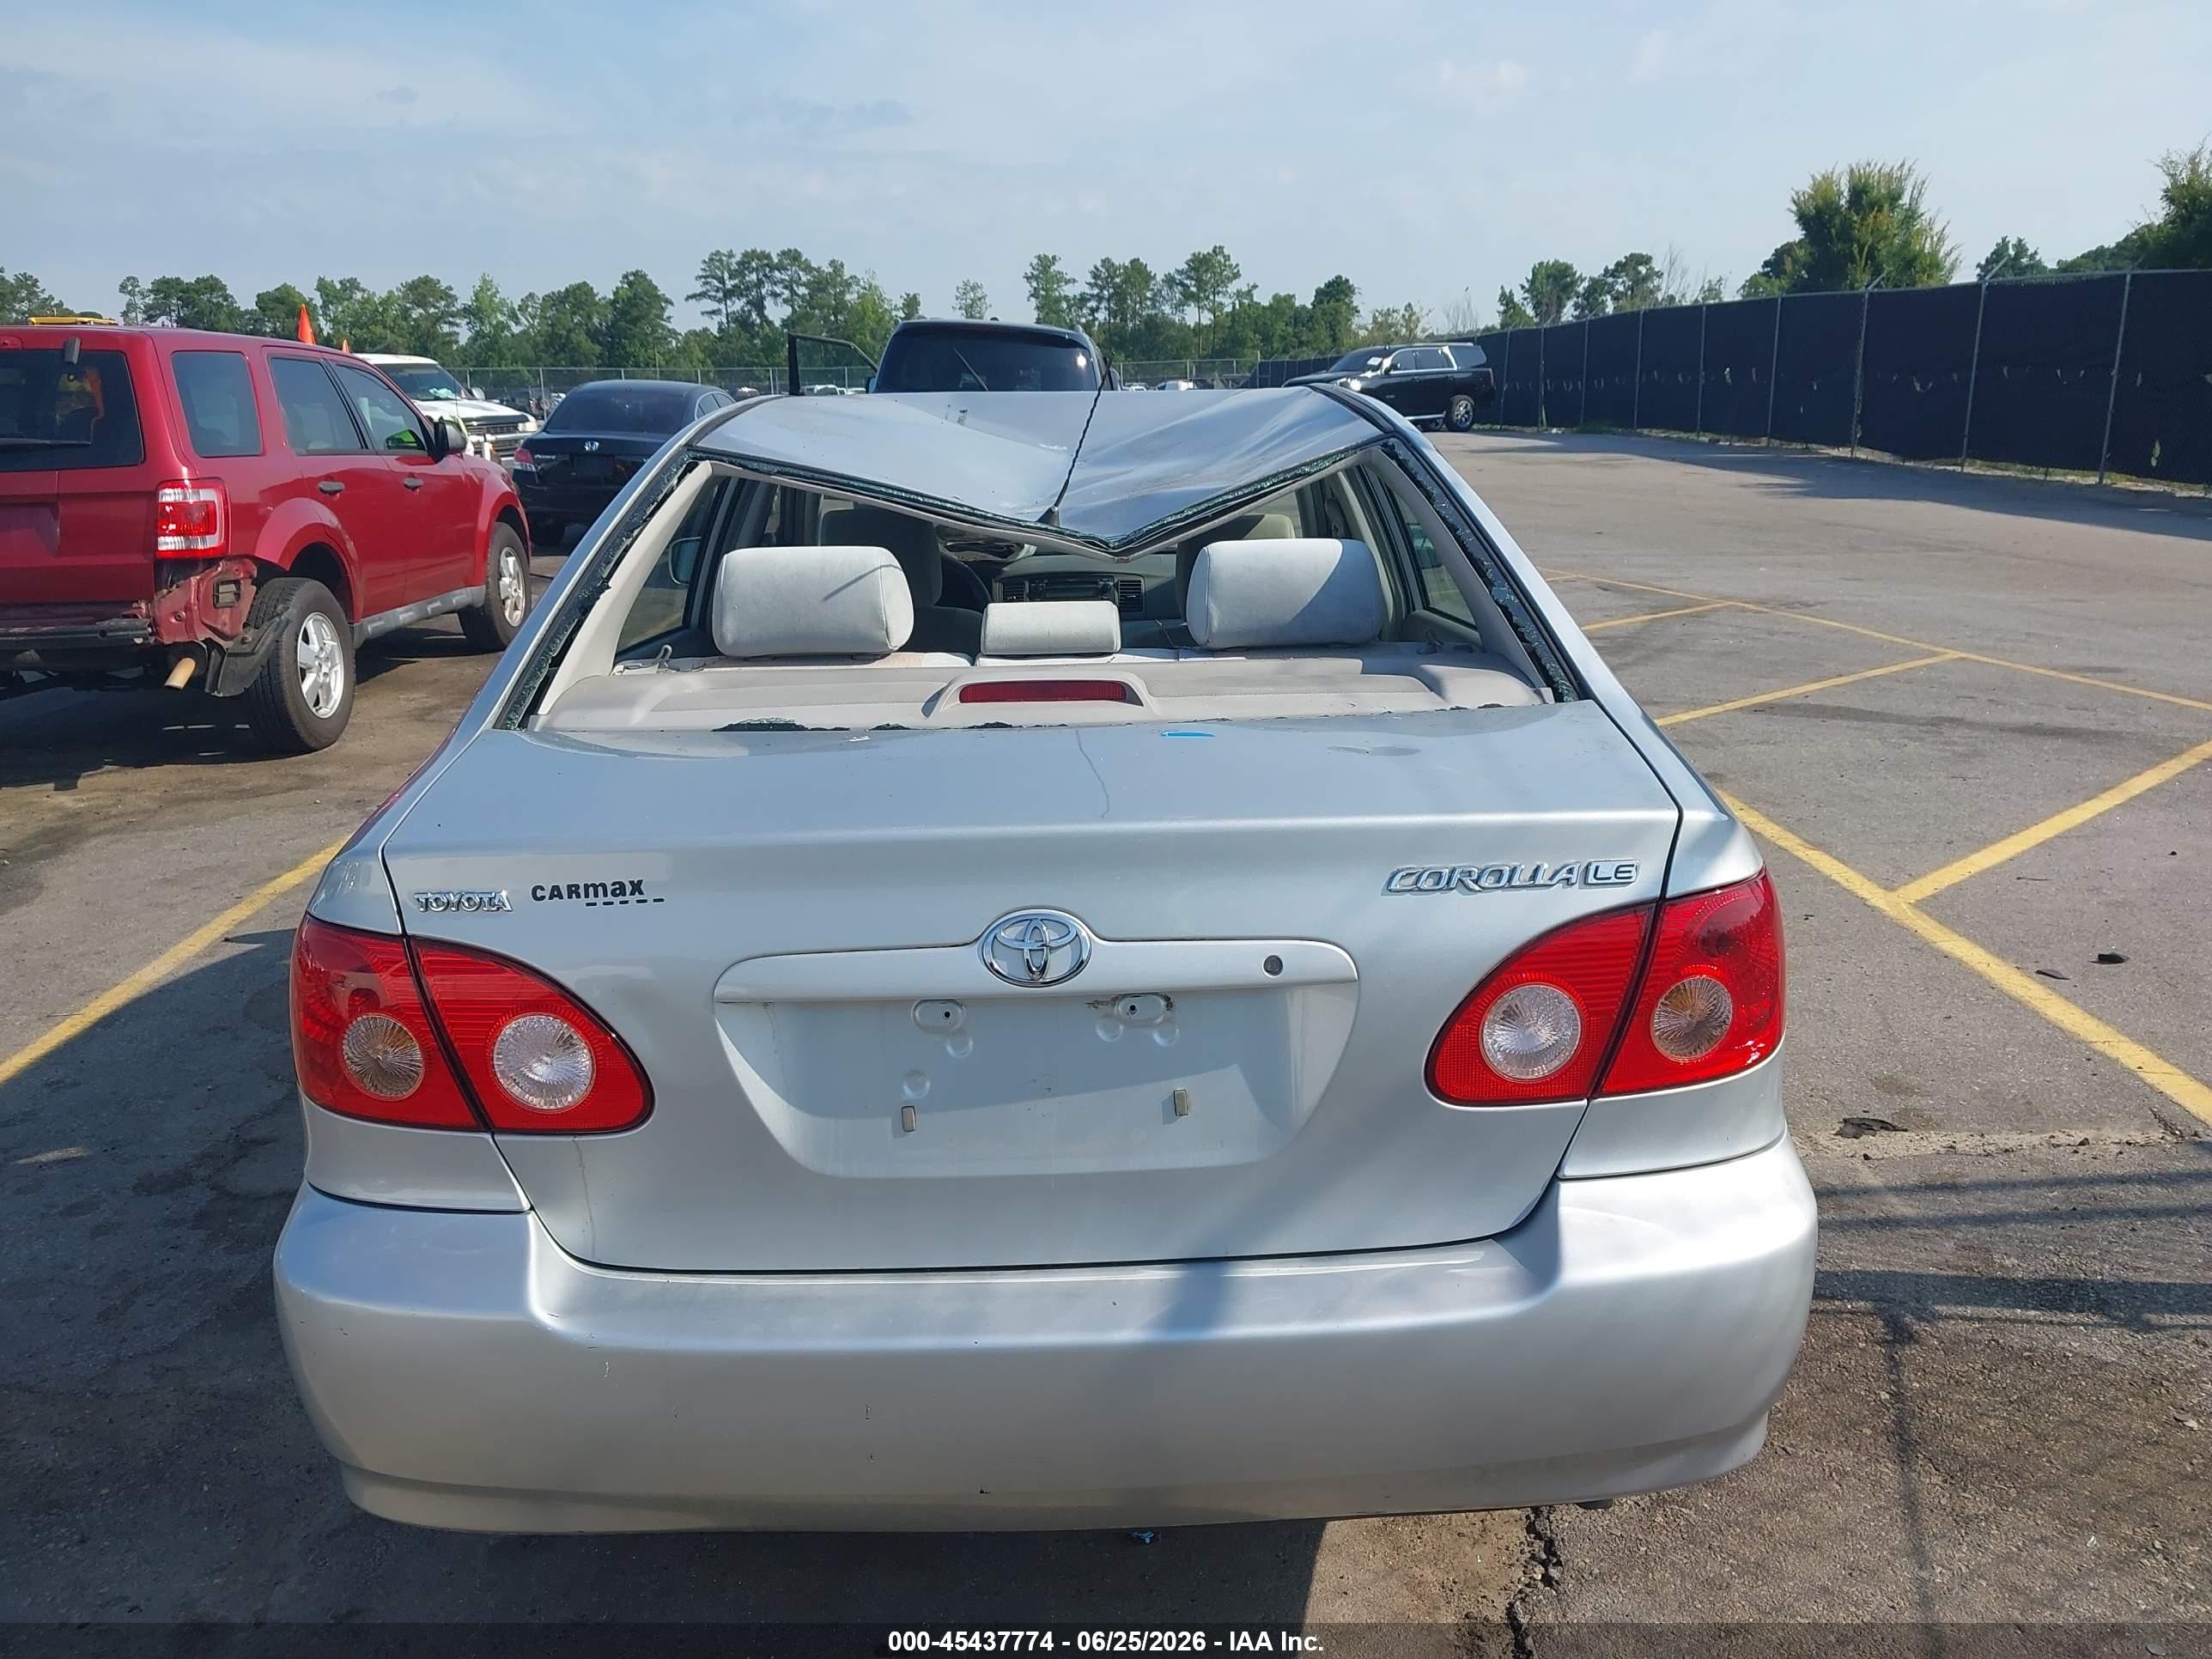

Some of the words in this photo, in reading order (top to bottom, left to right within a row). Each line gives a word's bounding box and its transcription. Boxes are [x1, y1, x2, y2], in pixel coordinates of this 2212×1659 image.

[1386, 861, 1582, 891] COROLLA
[1591, 861, 1637, 882] LE
[413, 890, 514, 913] TOYOTA
[531, 878, 645, 902] CARmax
